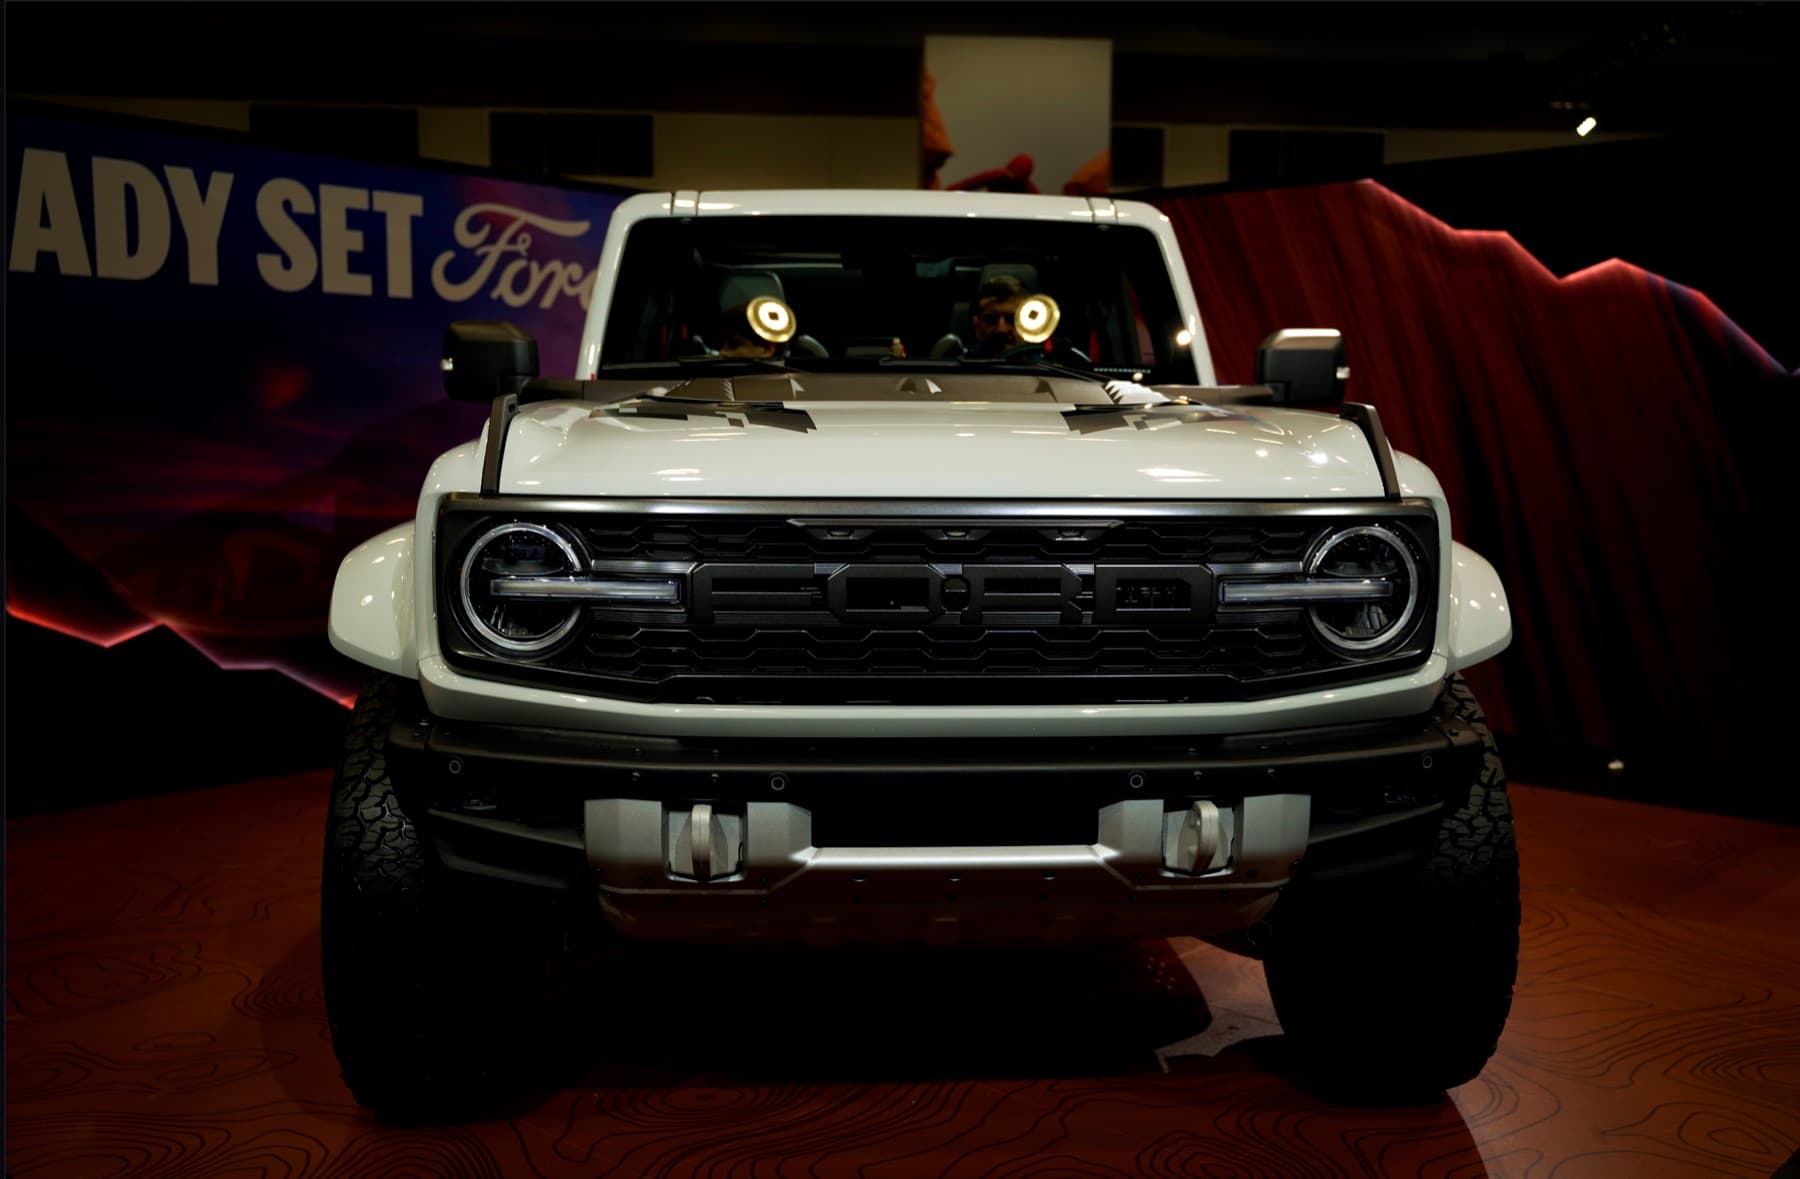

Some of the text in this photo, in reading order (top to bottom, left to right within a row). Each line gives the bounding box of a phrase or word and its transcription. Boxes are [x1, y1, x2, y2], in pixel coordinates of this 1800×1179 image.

[9, 147, 235, 286] ADY
[256, 177, 424, 299] SET
[691, 562, 1214, 625] FORD
